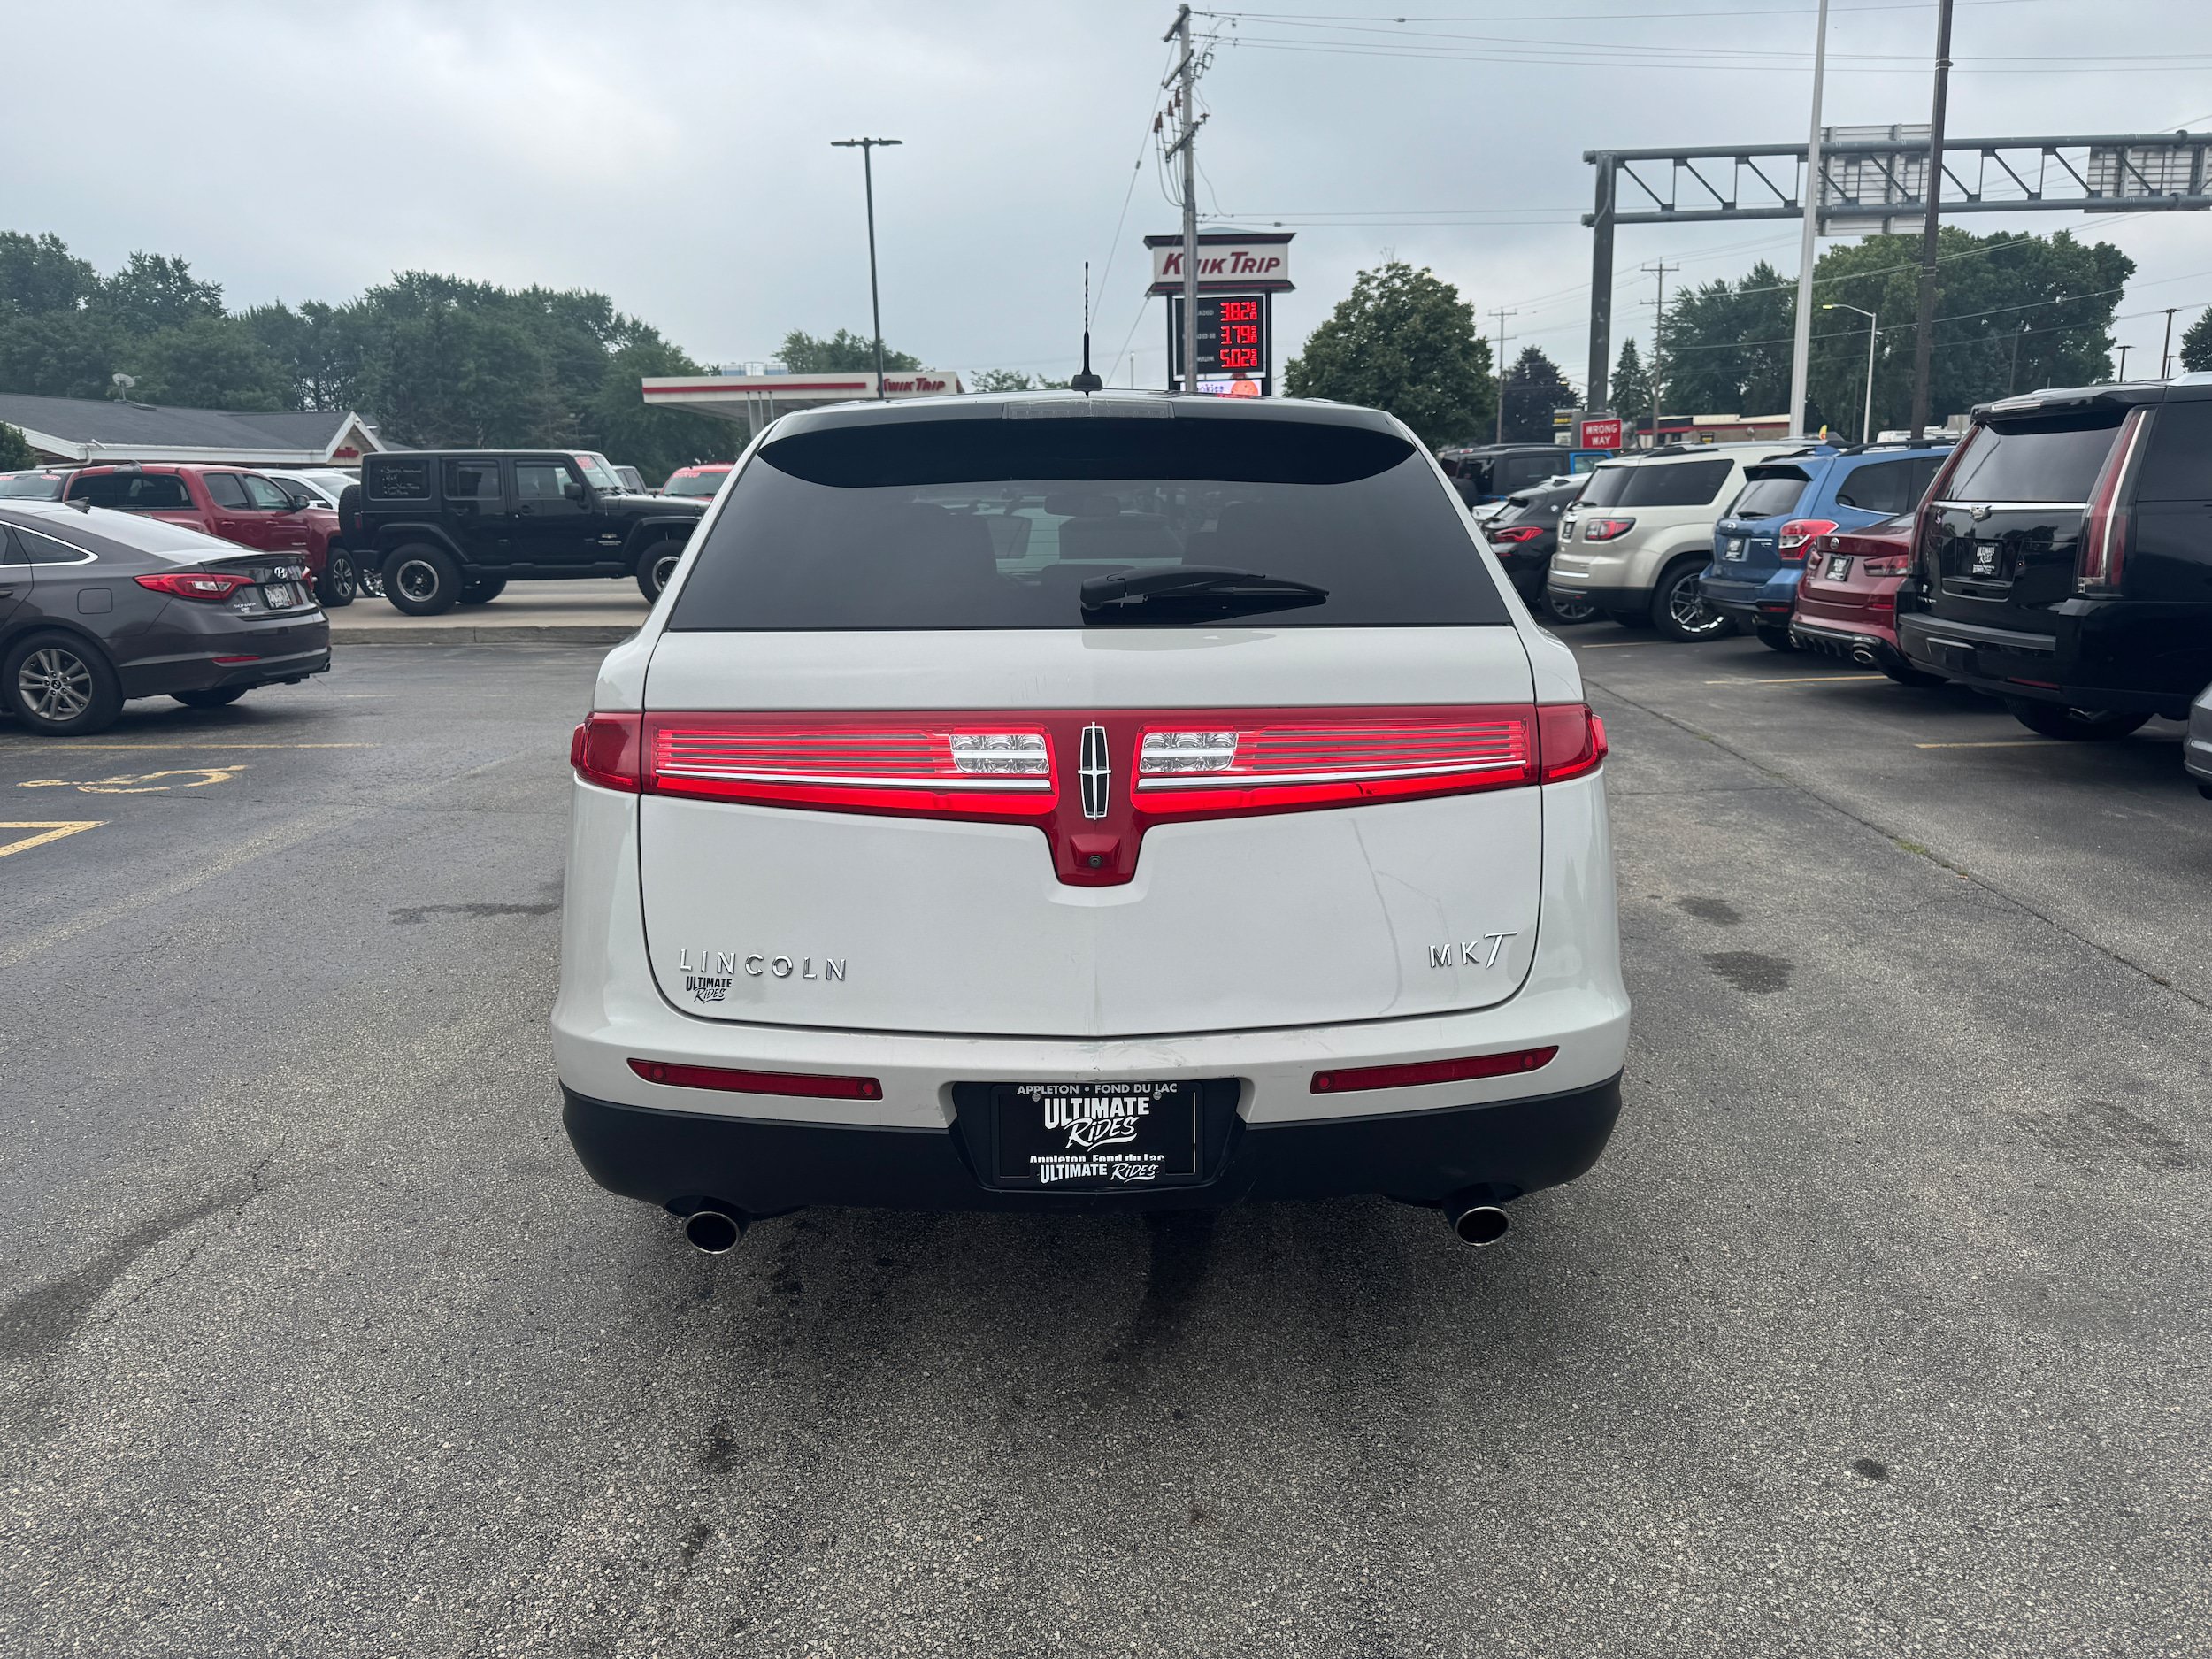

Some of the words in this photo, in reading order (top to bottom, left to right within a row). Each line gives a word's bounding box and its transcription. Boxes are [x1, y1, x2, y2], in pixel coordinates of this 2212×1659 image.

[1162, 252, 1227, 275] KIK
[1230, 251, 1280, 274] TRIP
[916, 377, 946, 391] TRIP
[1586, 423, 1618, 435] WRONG
[1591, 435, 1611, 445] WAY
[1428, 930, 1519, 970] MKT
[679, 948, 847, 982] LINCOLN
[686, 975, 733, 992] ULTIMATE
[1017, 1084, 1079, 1095] APPLETON
[1094, 1083, 1130, 1094] FOND
[1133, 1083, 1151, 1094] DU
[1154, 1082, 1178, 1094] LAC
[1043, 1096, 1150, 1130] ULTIMATE
[1092, 1154, 1123, 1163] Fond
[1040, 1164, 1108, 1184] ULTIMATE
